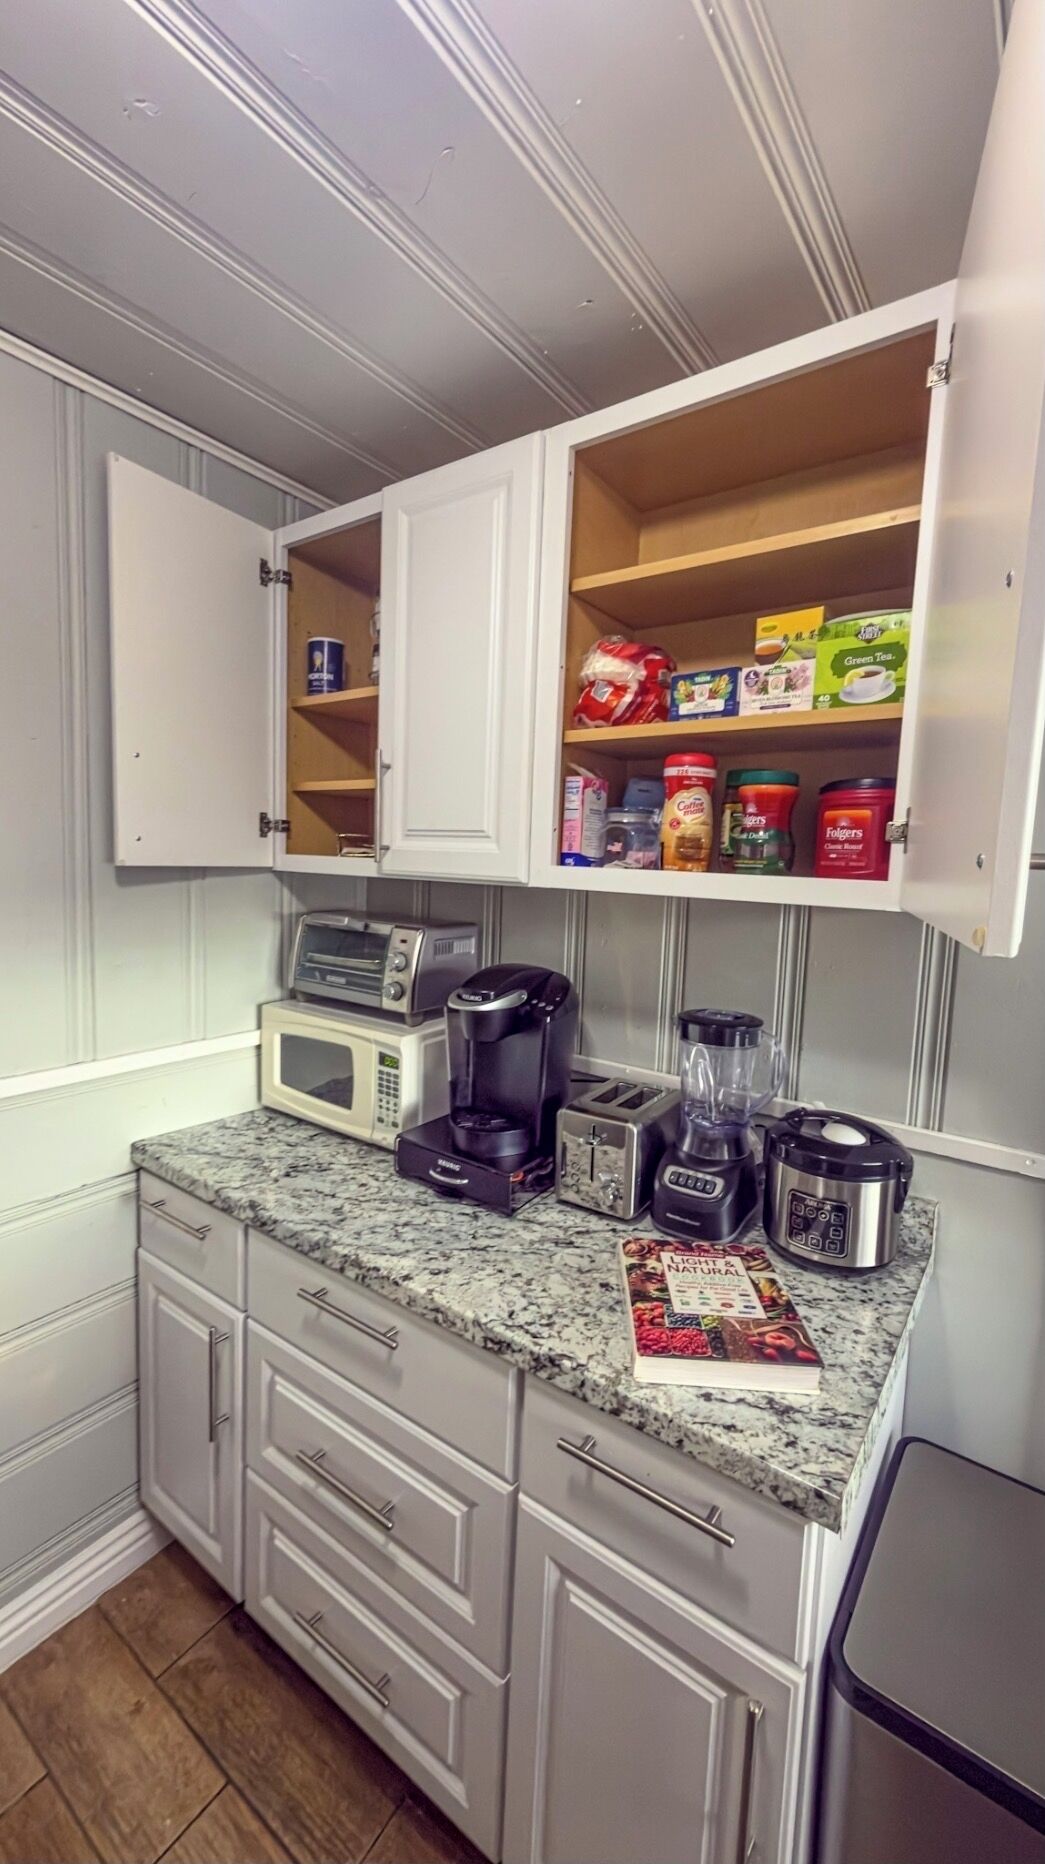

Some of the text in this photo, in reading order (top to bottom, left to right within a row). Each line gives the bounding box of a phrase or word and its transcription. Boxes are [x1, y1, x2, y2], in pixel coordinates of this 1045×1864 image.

[861, 624, 881, 635] FIRST
[857, 630, 884, 642] STREET
[844, 656, 874, 666] Green
[818, 694, 831, 702] 40
[677, 800, 705, 812] Coffee
[682, 807, 705, 817] mate
[825, 826, 864, 841] Folgers
[669, 1255, 736, 1268] LIGHT &
[667, 1264, 745, 1277] NATURAL
[672, 1273, 746, 1285] COOKBOOK
